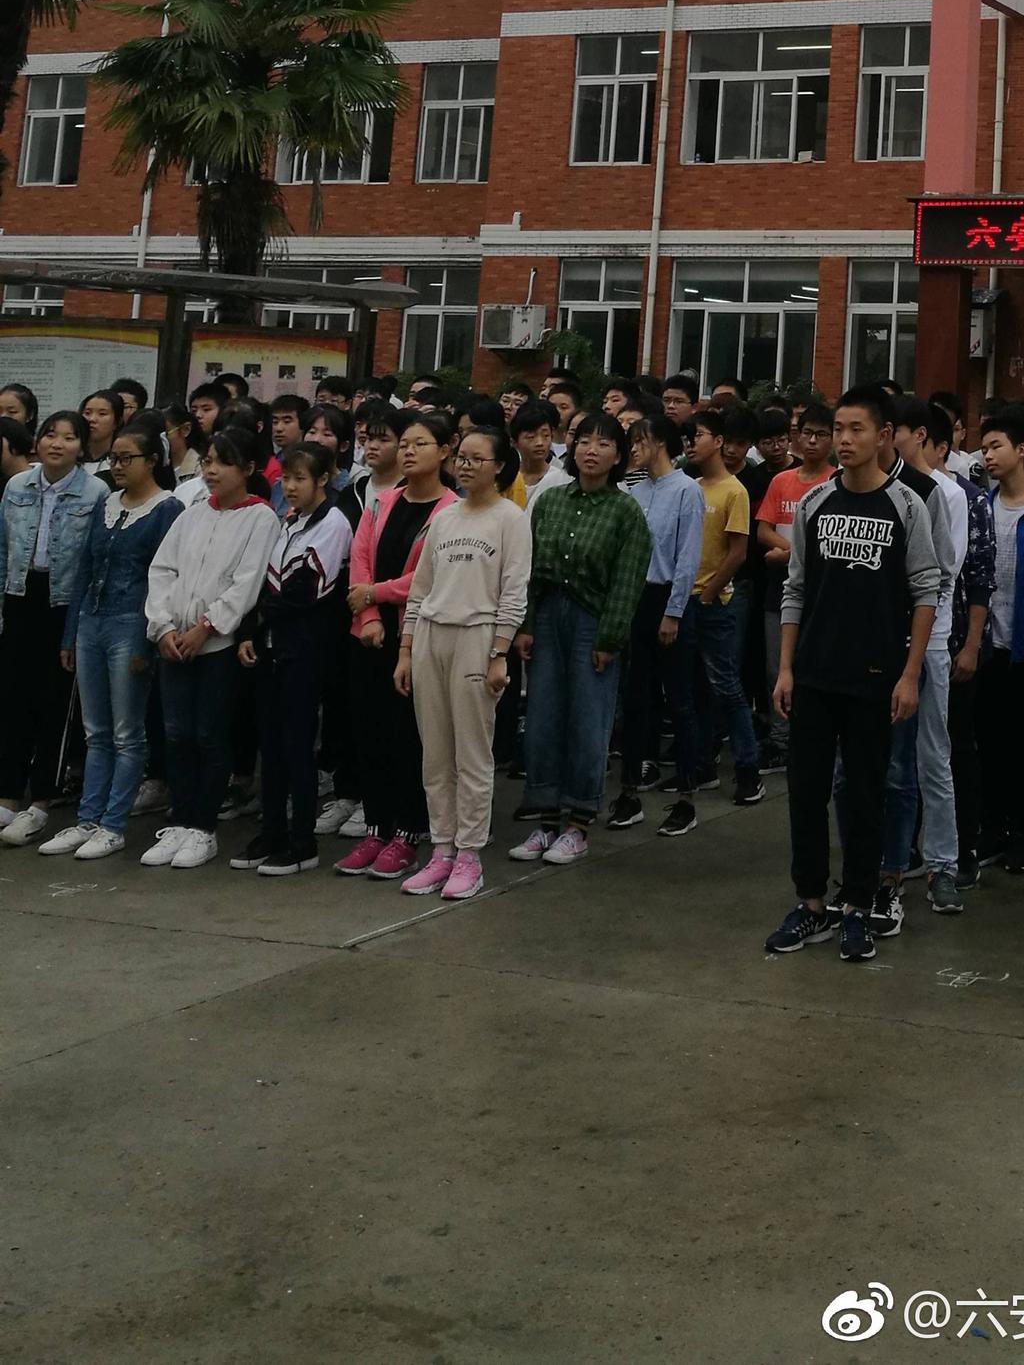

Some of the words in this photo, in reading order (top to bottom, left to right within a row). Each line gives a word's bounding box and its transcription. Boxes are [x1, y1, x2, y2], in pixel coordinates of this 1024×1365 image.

[818, 515, 847, 540] TOP
[846, 516, 894, 546] REBEL
[829, 539, 872, 561] VIRUS
